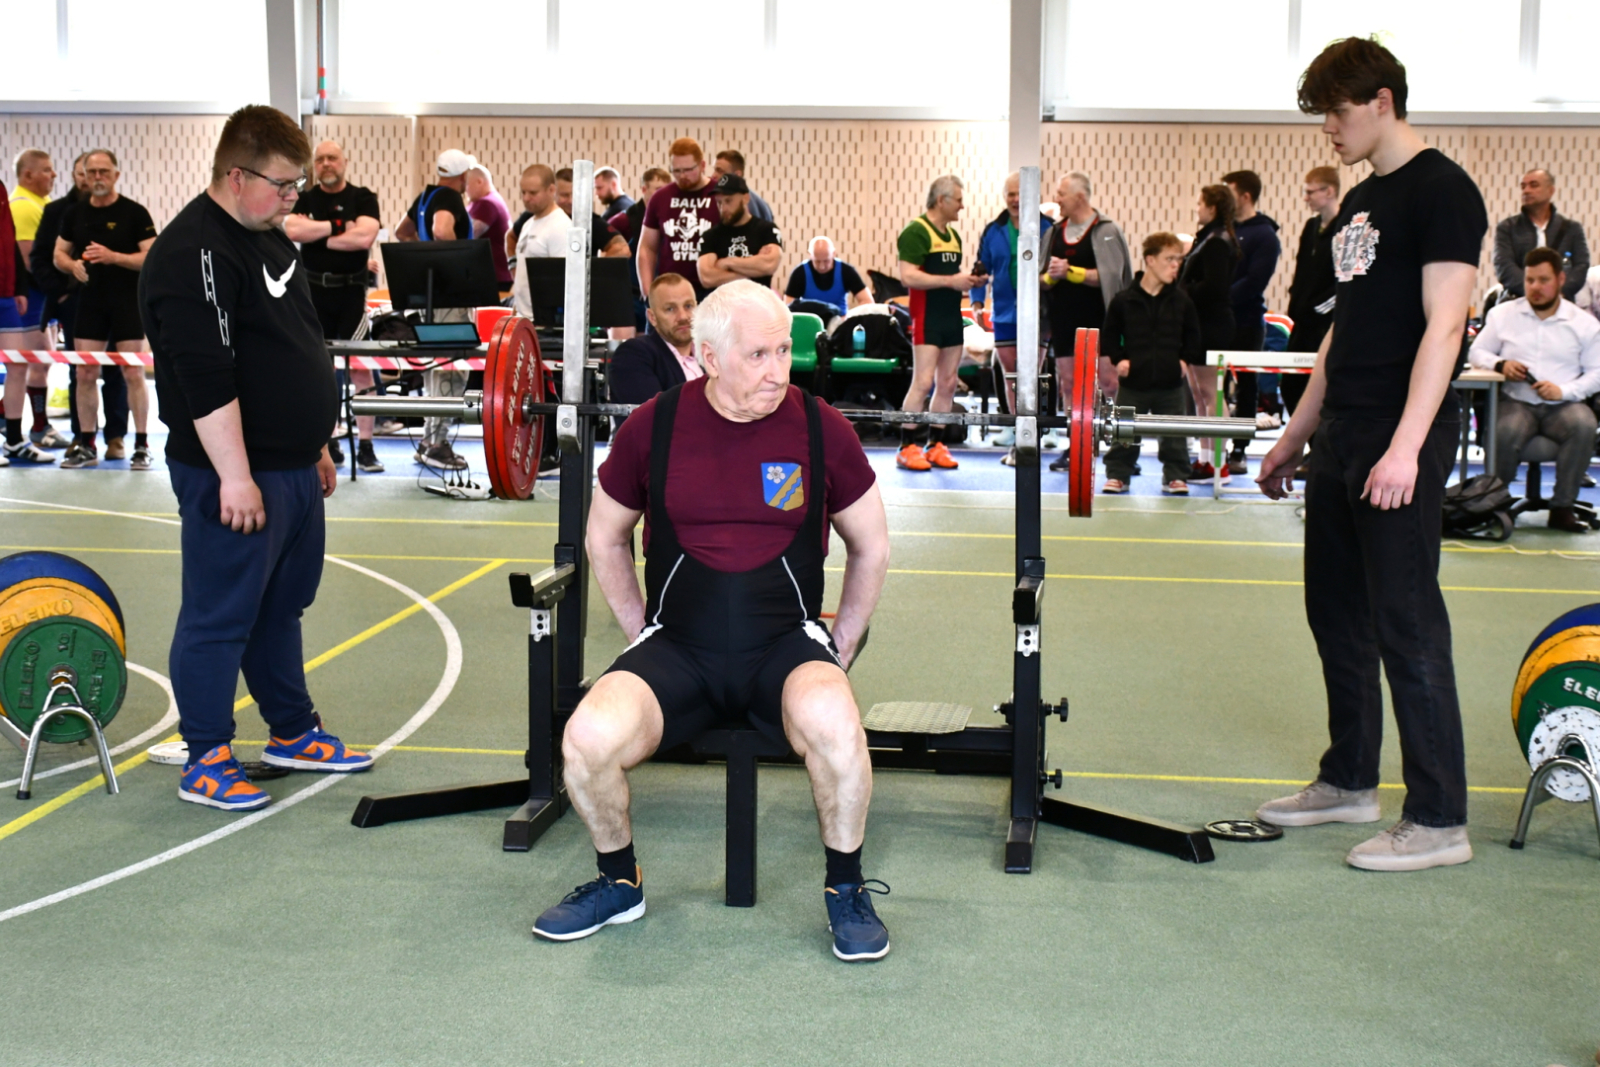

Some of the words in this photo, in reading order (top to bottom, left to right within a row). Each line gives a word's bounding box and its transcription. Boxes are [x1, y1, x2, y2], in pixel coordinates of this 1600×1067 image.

[670, 197, 711, 208] BALVI
[673, 251, 699, 261] GYM
[942, 252, 957, 262] LTU
[0, 598, 73, 632] ELEIKO
[18, 640, 40, 709] ELEIKO
